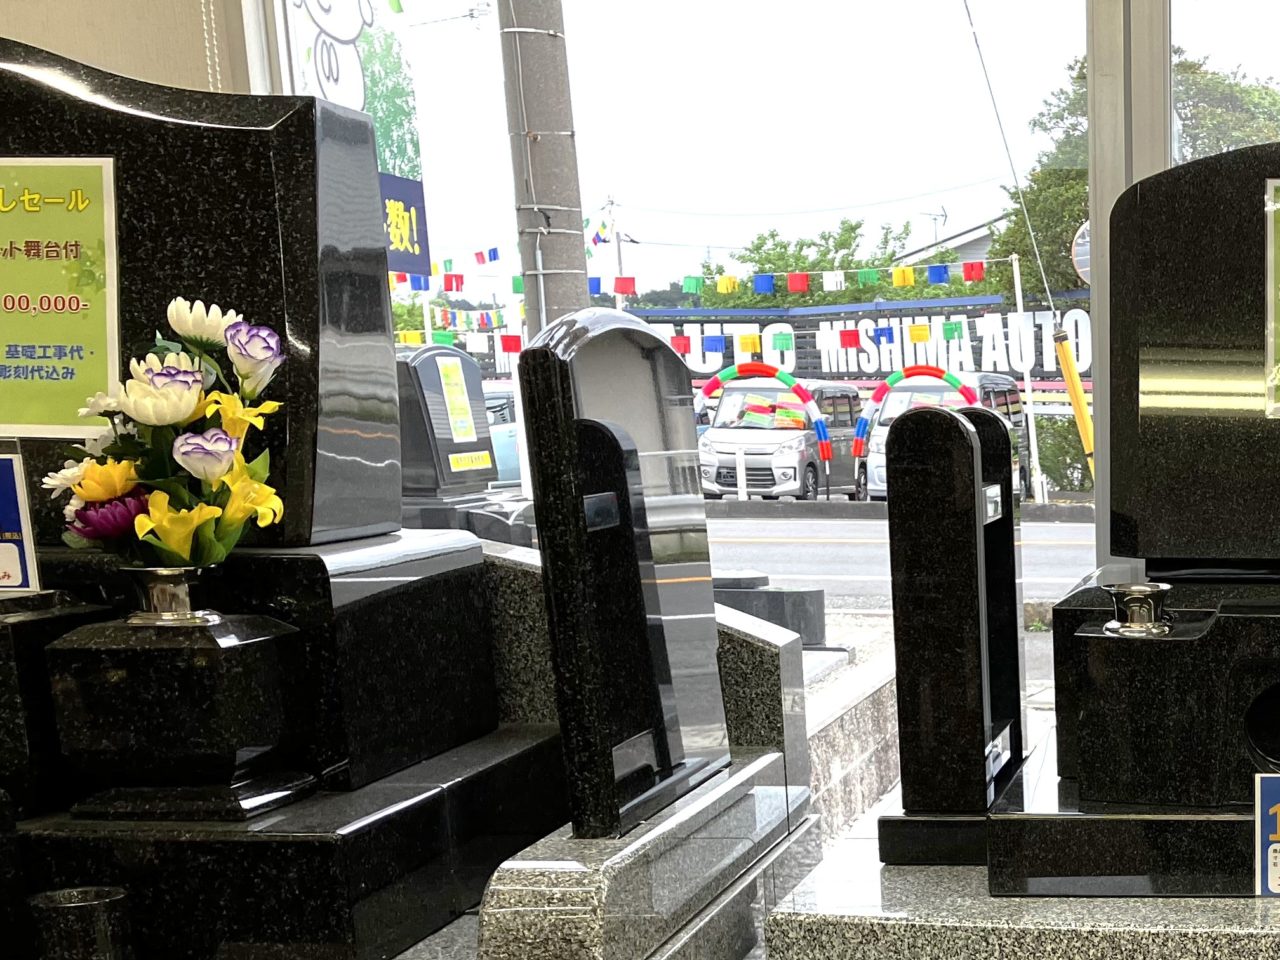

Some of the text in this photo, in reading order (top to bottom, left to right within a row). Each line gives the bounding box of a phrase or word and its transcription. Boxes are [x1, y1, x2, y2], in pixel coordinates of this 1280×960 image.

[384, 198, 420, 256] 数!
[816, 314, 975, 372] MISHIMA
[978, 308, 1093, 374] AUTO
